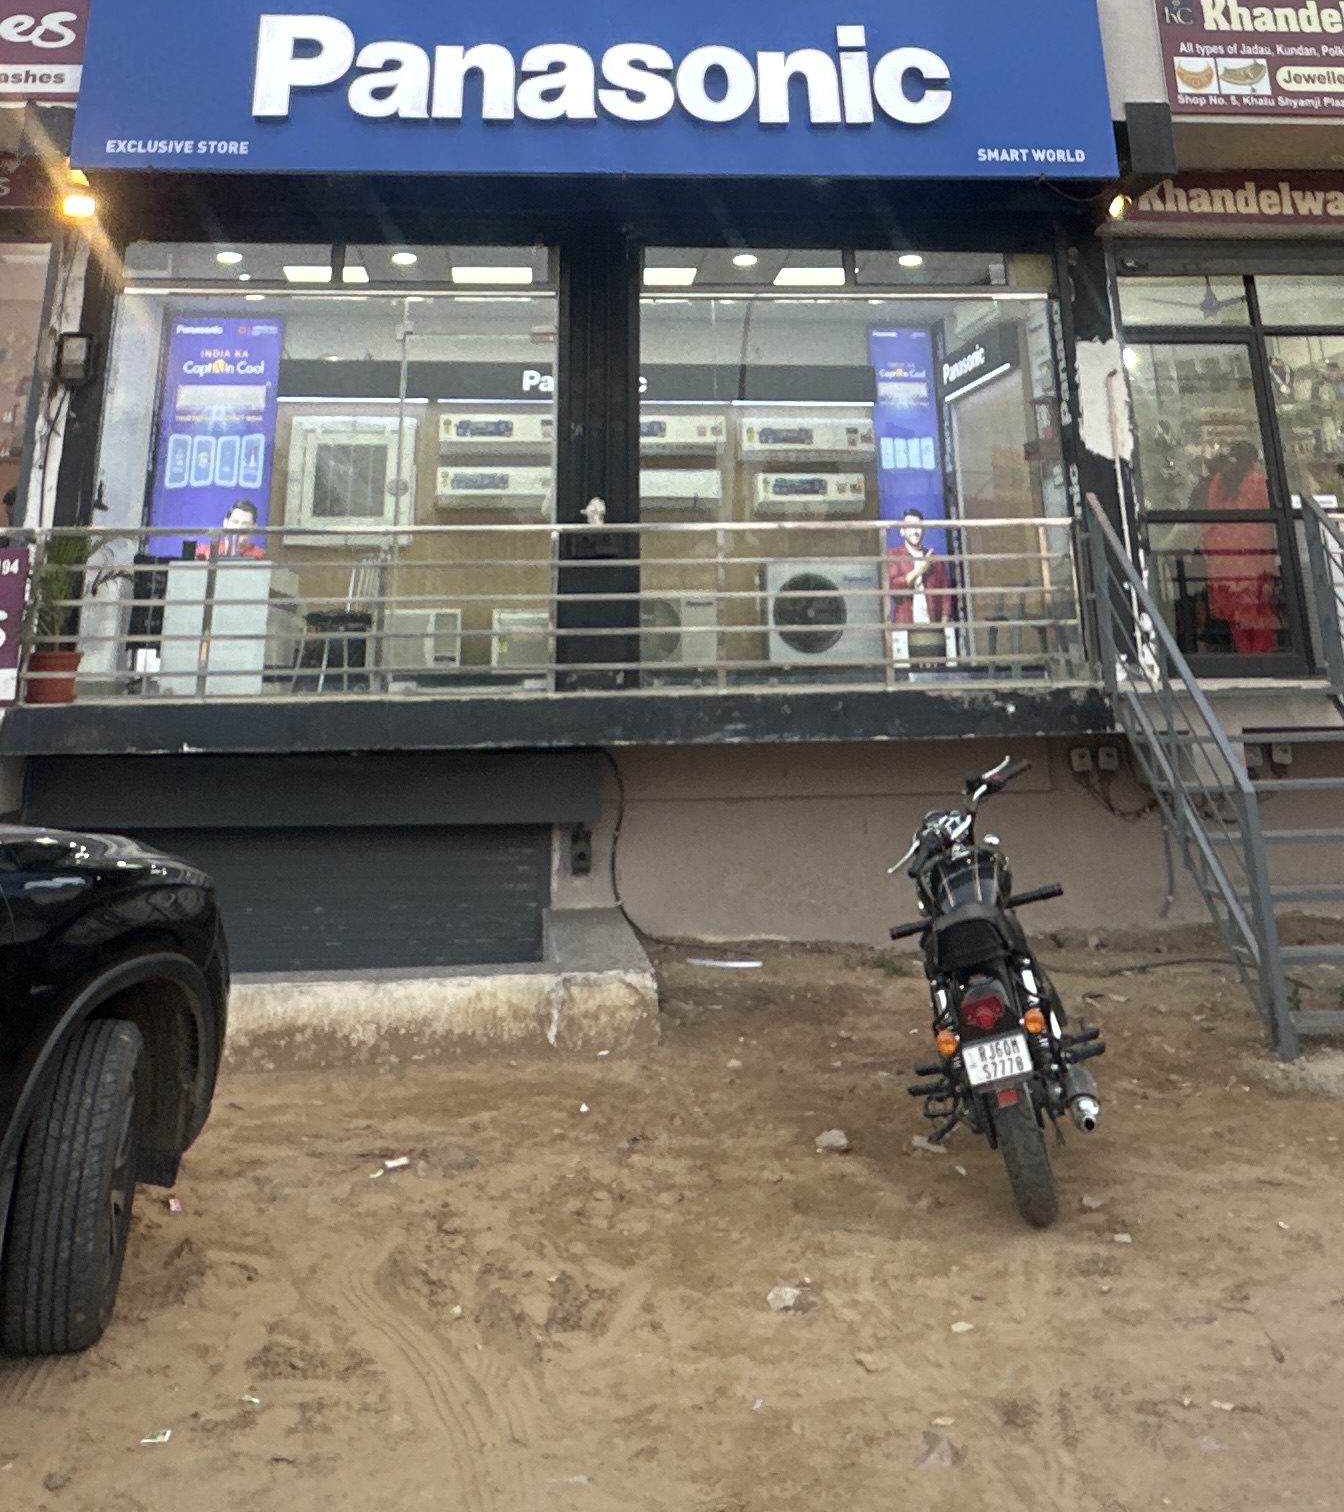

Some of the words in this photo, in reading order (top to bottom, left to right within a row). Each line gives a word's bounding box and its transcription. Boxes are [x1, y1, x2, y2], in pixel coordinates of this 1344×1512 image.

[1179, 42, 1193, 54] All
[1195, 44, 1224, 56] types
[1227, 43, 1238, 54] of
[1276, 44, 1319, 57] Kundan,
[251, 13, 953, 126] Panasonic
[1177, 94, 1206, 106] Shop
[1209, 94, 1227, 105] No.
[1243, 96, 1275, 106] Khatu
[1278, 96, 1322, 108] Shyamji
[106, 139, 194, 154] EXCLUSIVE
[197, 140, 249, 155] STORE
[977, 148, 1029, 162] SMART
[1031, 148, 1086, 163] WORLD
[237, 360, 265, 375] Cool
[943, 344, 985, 385] Panasonic
